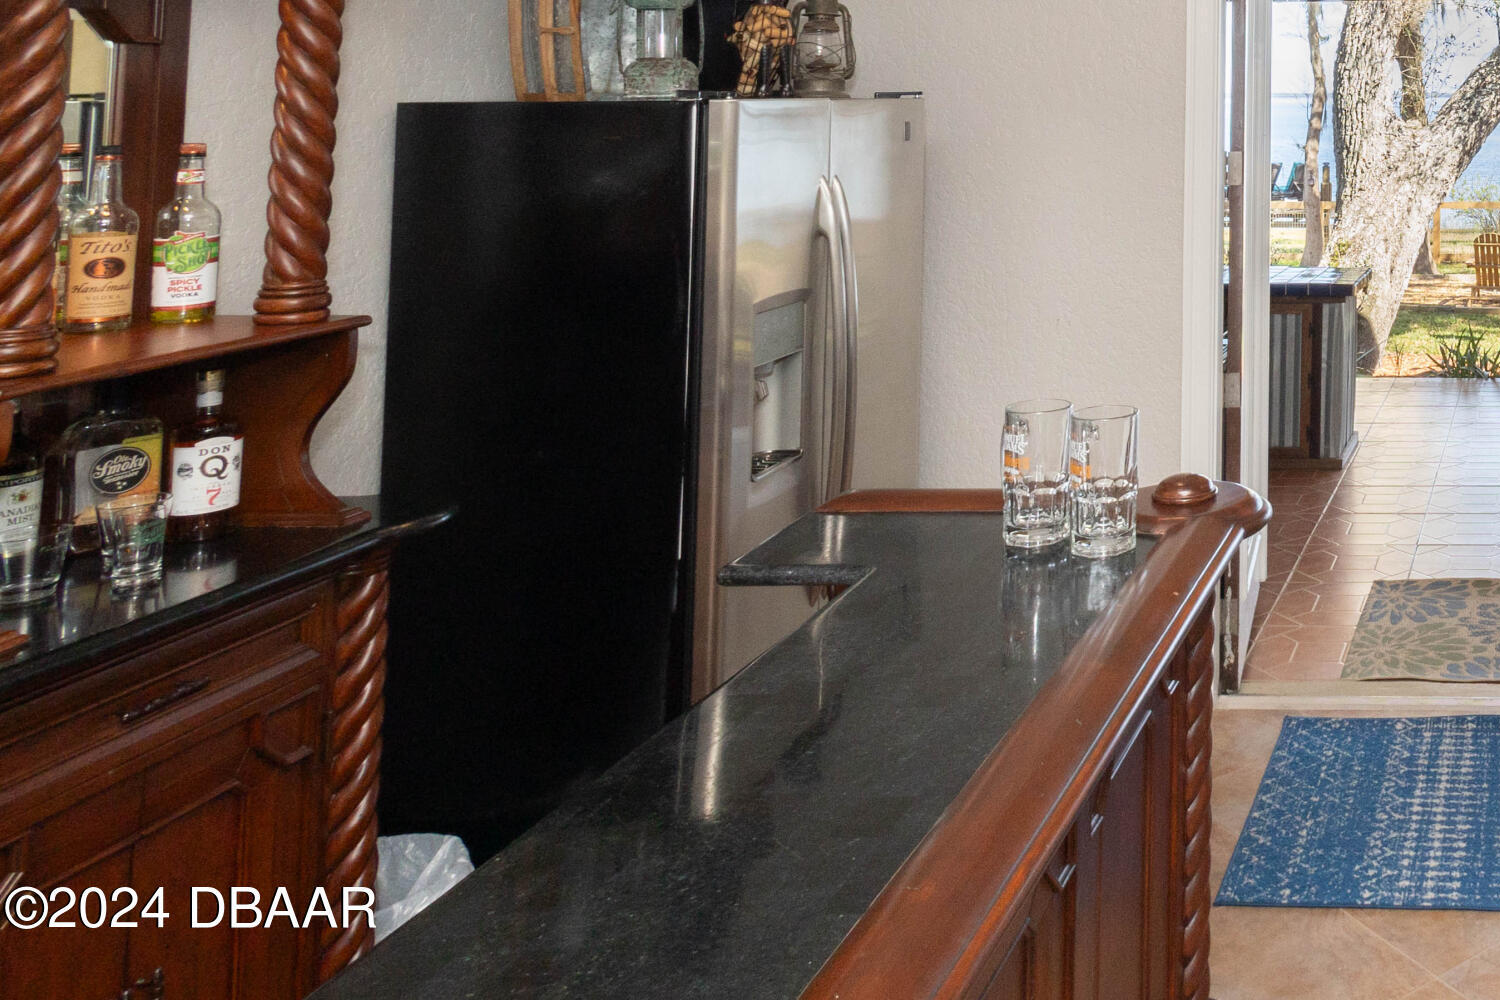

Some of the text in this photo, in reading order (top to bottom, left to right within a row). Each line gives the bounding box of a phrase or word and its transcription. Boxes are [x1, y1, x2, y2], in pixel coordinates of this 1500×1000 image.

[80, 239, 132, 255] Tito's
[167, 284, 203, 293] PICKLE
[170, 278, 200, 286] SPICY
[199, 444, 231, 457] DON
[93, 455, 148, 479] Smoky
[200, 455, 229, 480] Q
[206, 487, 222, 506] 7
